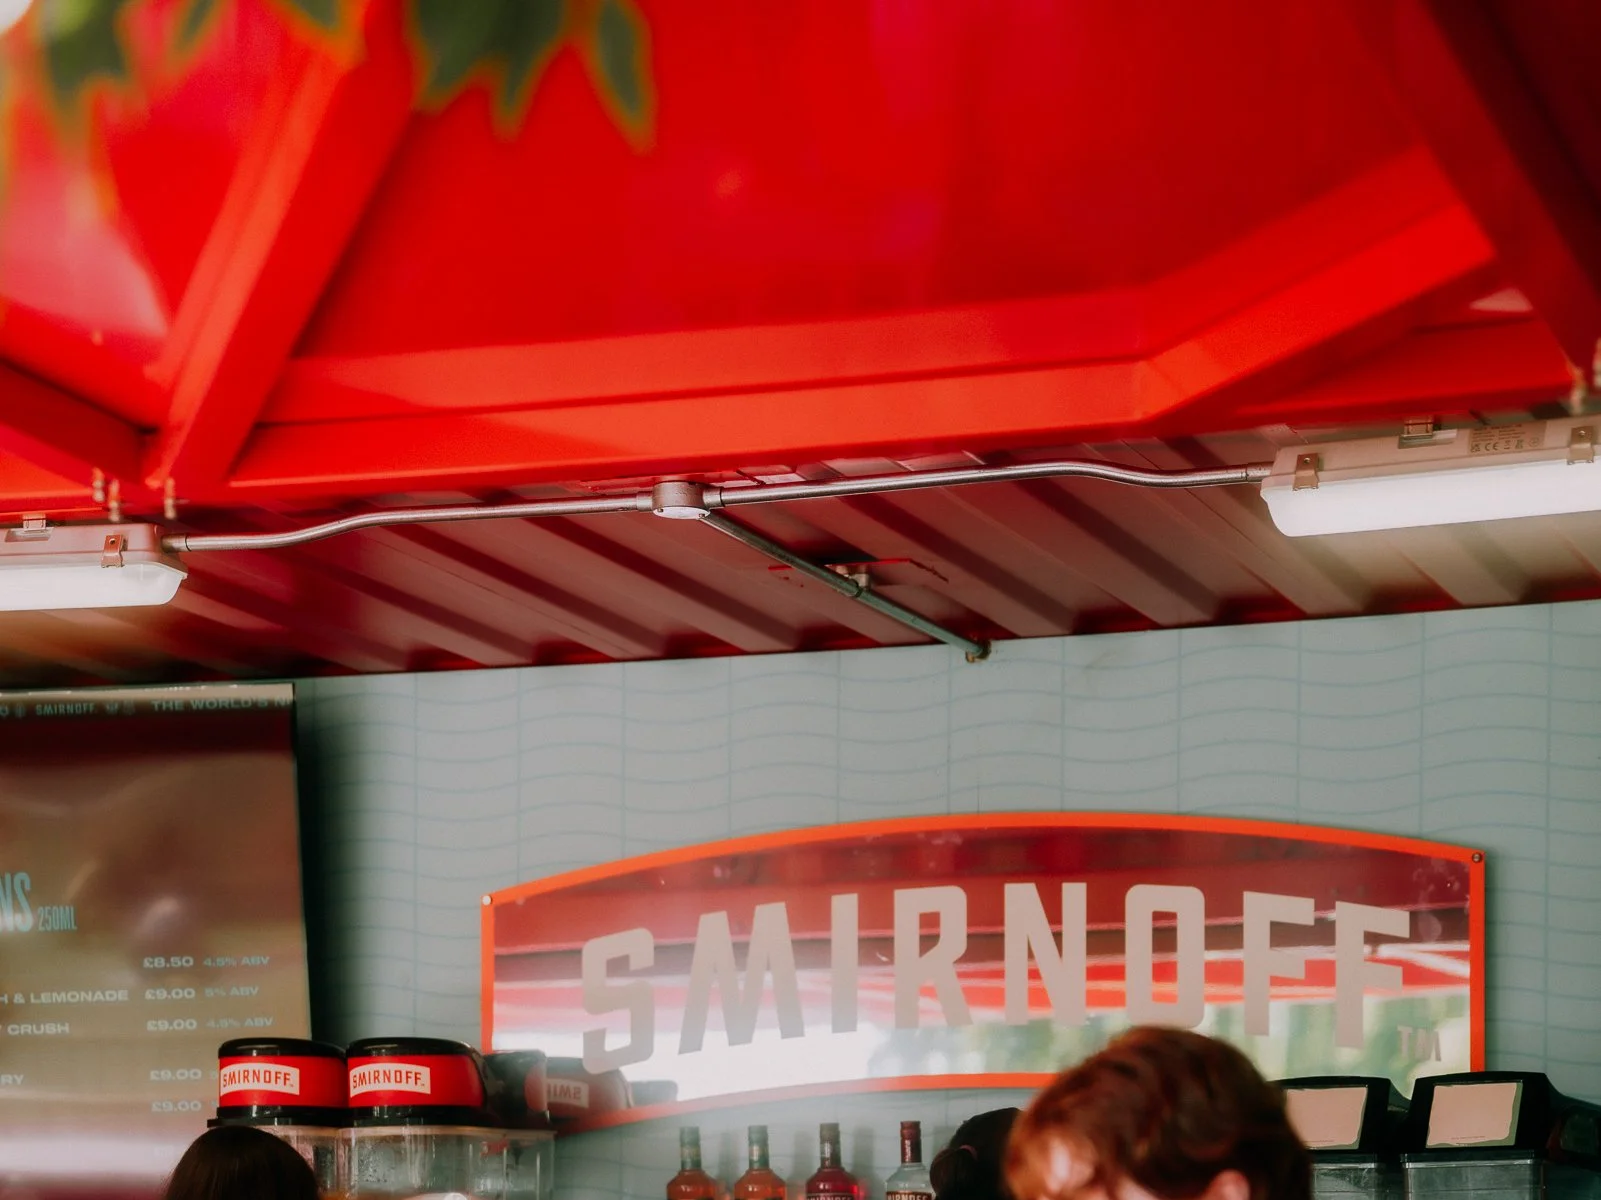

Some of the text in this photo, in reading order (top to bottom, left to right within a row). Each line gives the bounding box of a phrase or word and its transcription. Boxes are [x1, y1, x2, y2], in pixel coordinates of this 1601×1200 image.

[35, 703, 95, 716] SMIRNOFF
[152, 700, 184, 711] THE
[190, 697, 268, 710] WORLD'S
[38, 905, 77, 932] 250ML
[143, 956, 194, 968] £8.50
[583, 882, 1410, 1074] SMIRNOFF
[13, 993, 25, 1004] &
[30, 990, 129, 1003] LEMONADE
[145, 988, 195, 1000] £9.00
[7, 1023, 70, 1035] CRUSH
[147, 1018, 197, 1031] £9.00
[150, 1068, 202, 1080] £9.00
[223, 1069, 291, 1088] SMIRNOFF
[353, 1069, 421, 1089] SMIRNOFF
[152, 1100, 202, 1112] £9.00
